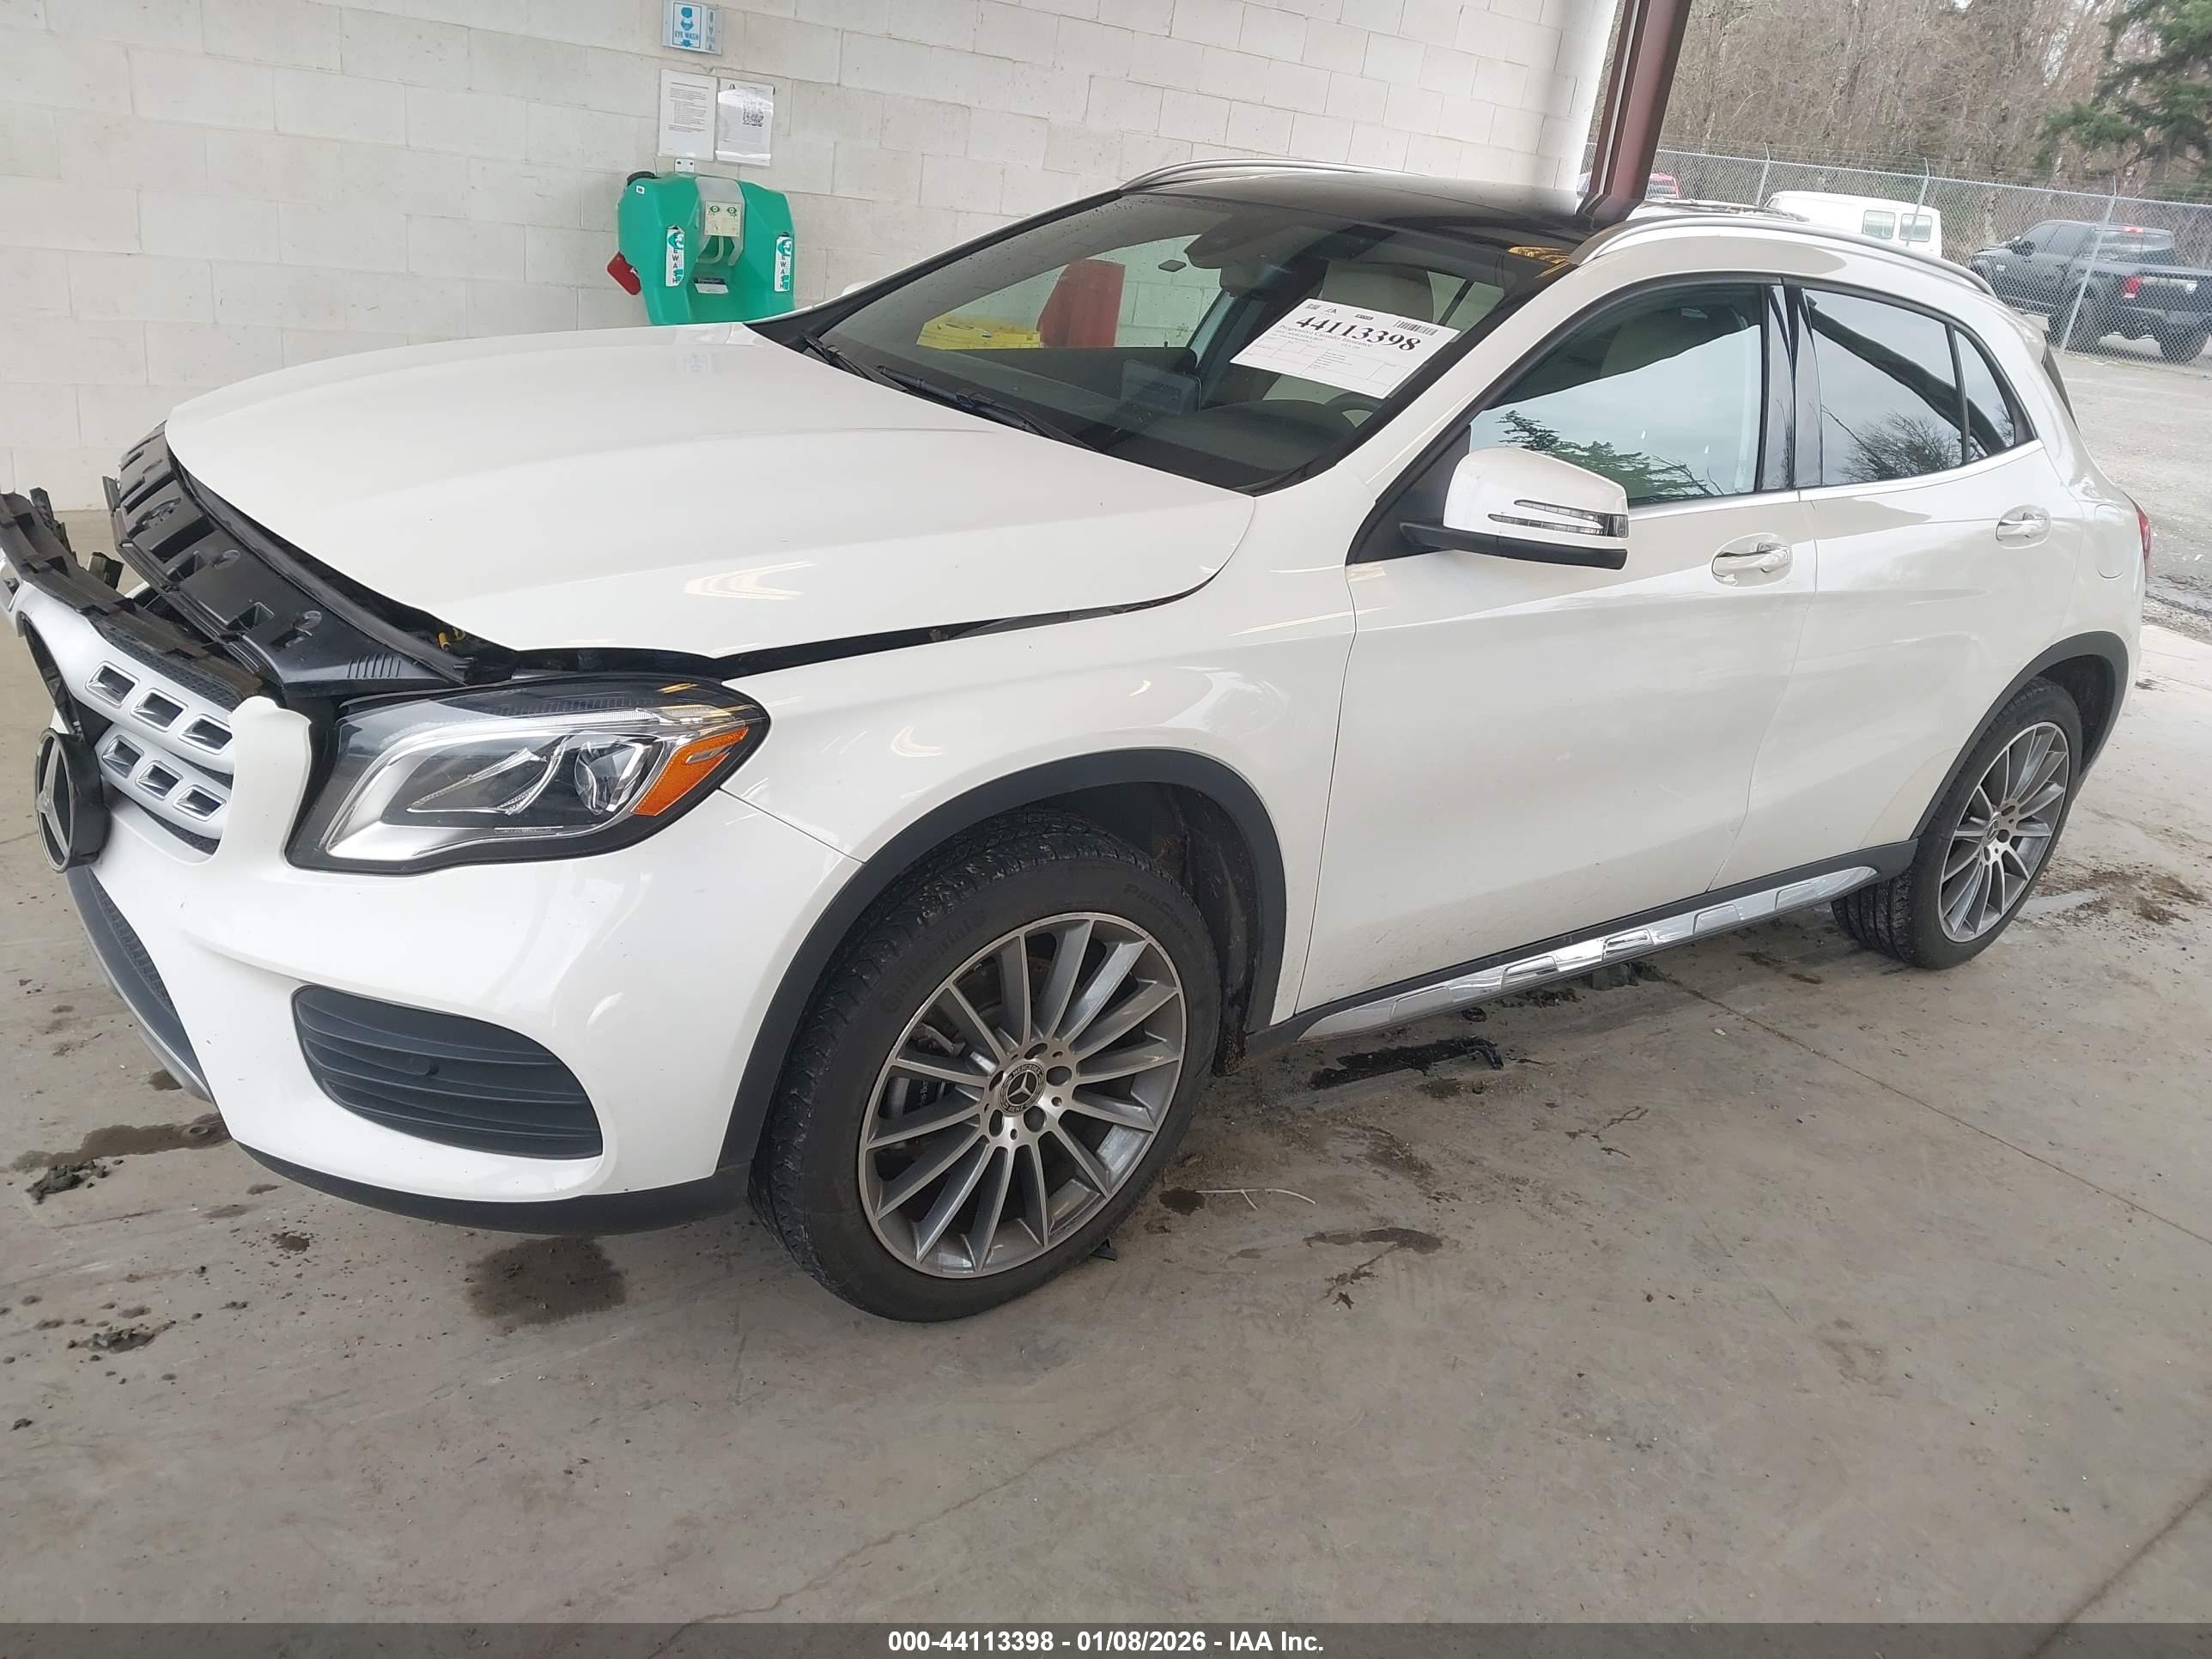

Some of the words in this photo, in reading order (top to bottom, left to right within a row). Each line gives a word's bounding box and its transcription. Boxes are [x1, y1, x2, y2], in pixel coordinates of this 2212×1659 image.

[674, 30, 684, 39] EYE
[684, 32, 699, 40] WASH
[1296, 316, 1421, 351] 44113398
[1012, 1064, 1042, 1077] MERCEDES
[1008, 1105, 1024, 1114] BENZ
